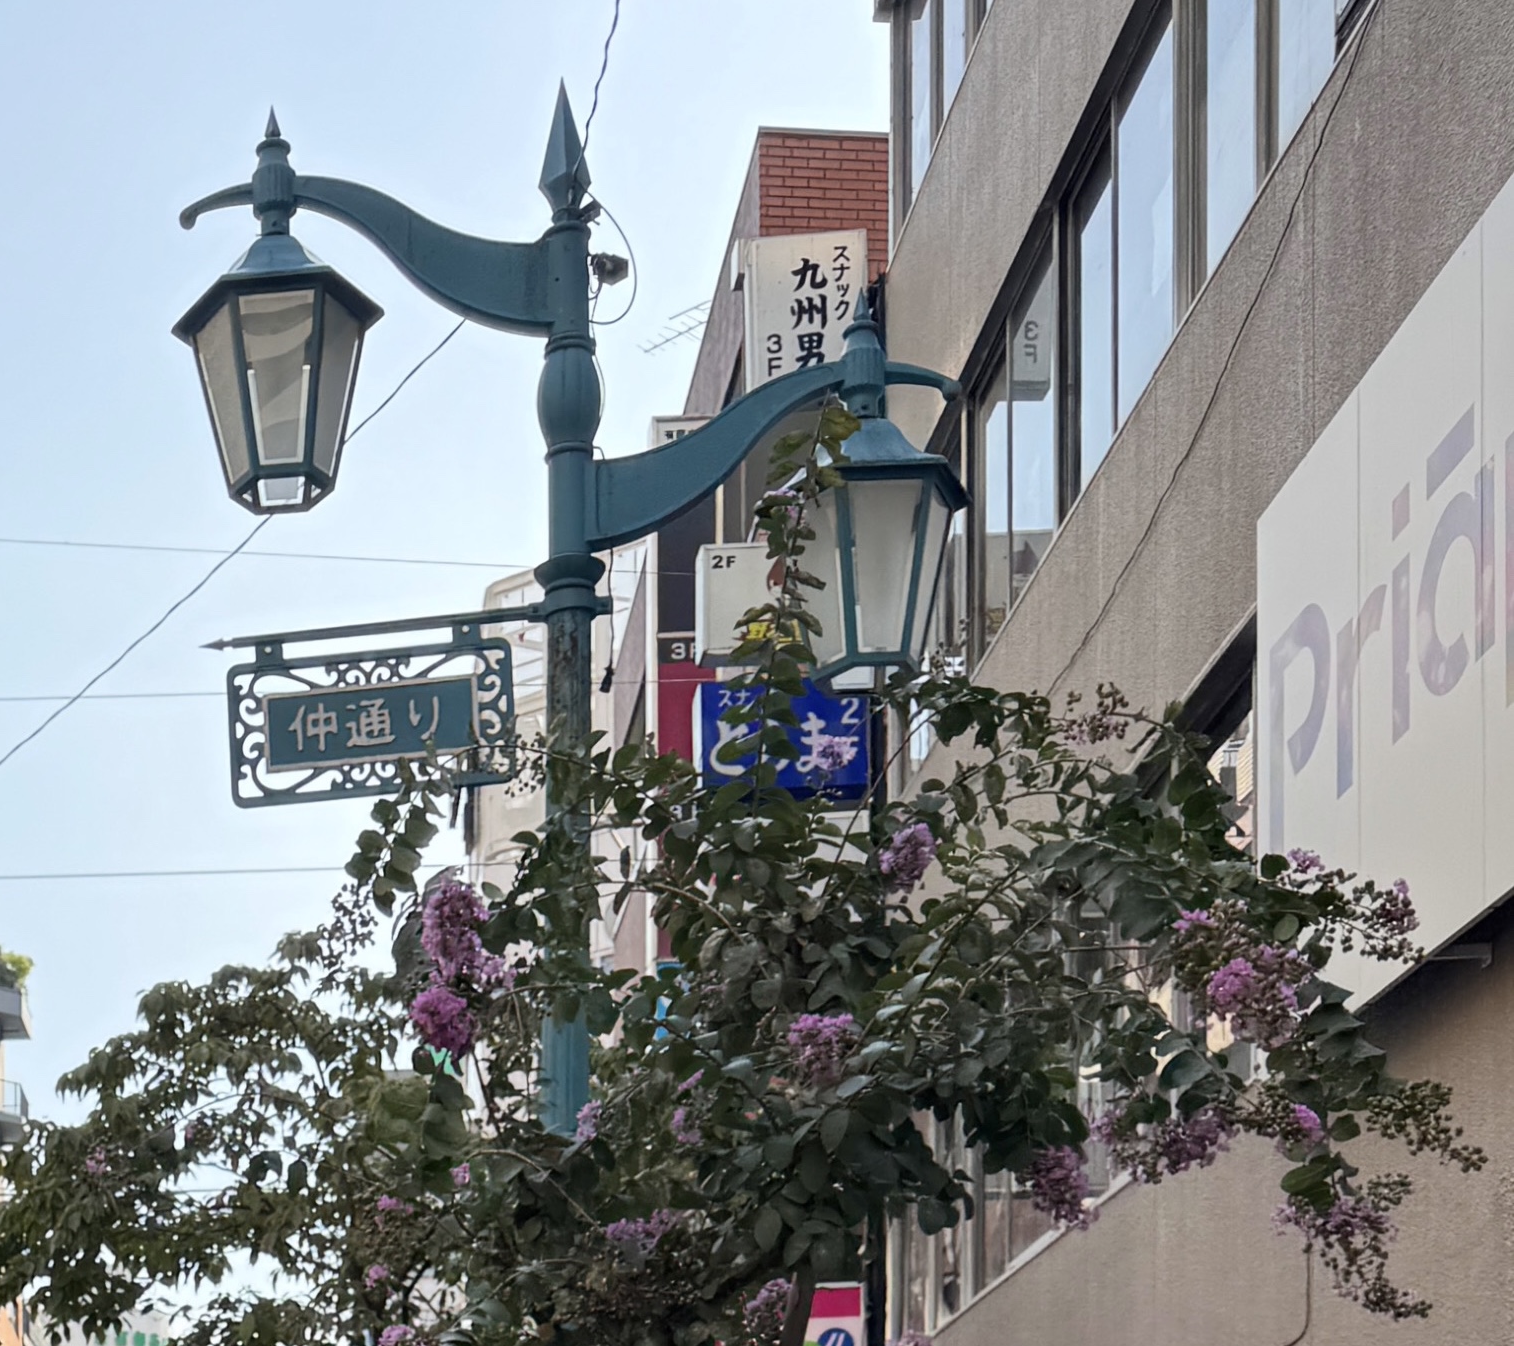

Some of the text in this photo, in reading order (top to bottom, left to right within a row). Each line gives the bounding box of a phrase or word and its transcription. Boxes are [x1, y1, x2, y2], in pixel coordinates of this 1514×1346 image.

[832, 246, 850, 321] スナック
[766, 333, 783, 377] 3F
[711, 554, 736, 569] 2F
[288, 696, 439, 752] 仲通り
